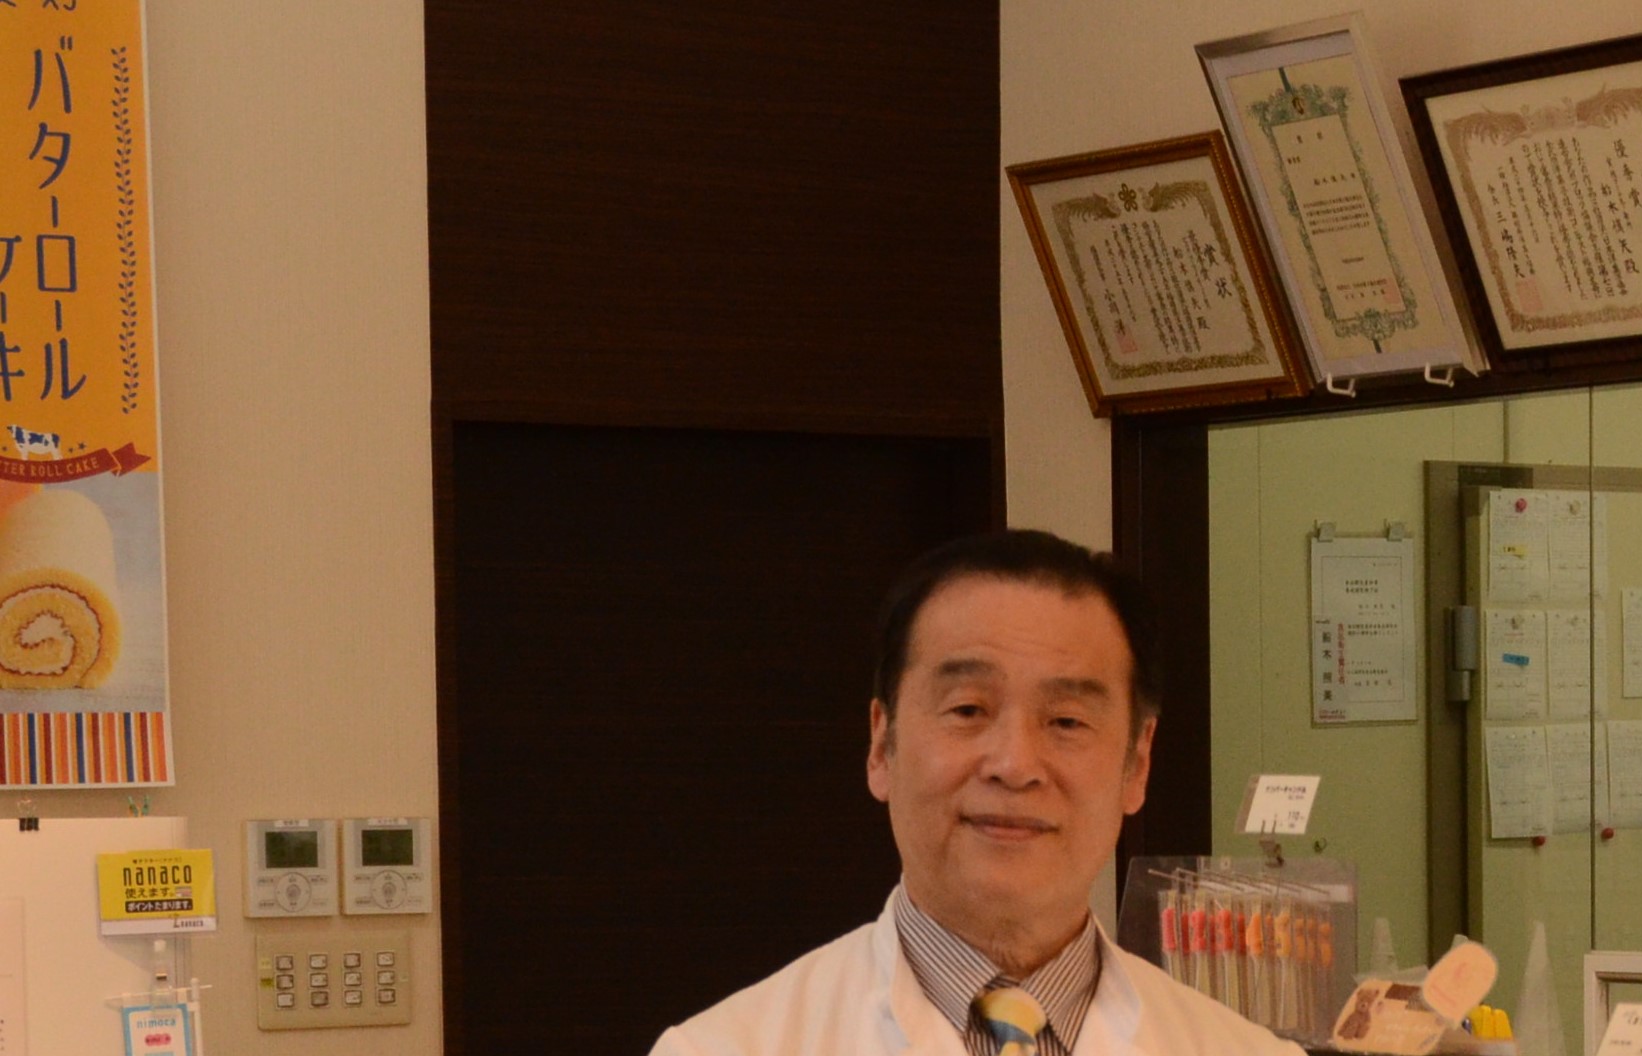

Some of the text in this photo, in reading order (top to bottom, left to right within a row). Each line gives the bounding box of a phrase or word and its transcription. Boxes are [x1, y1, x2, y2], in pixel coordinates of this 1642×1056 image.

[28, 35, 86, 400] バターロール
[1200, 243, 1233, 298] 賞状
[30, 464, 63, 477] ROLL
[66, 457, 100, 475] CAKE
[123, 865, 192, 886] nanaco
[136, 1018, 177, 1029] nimoca
